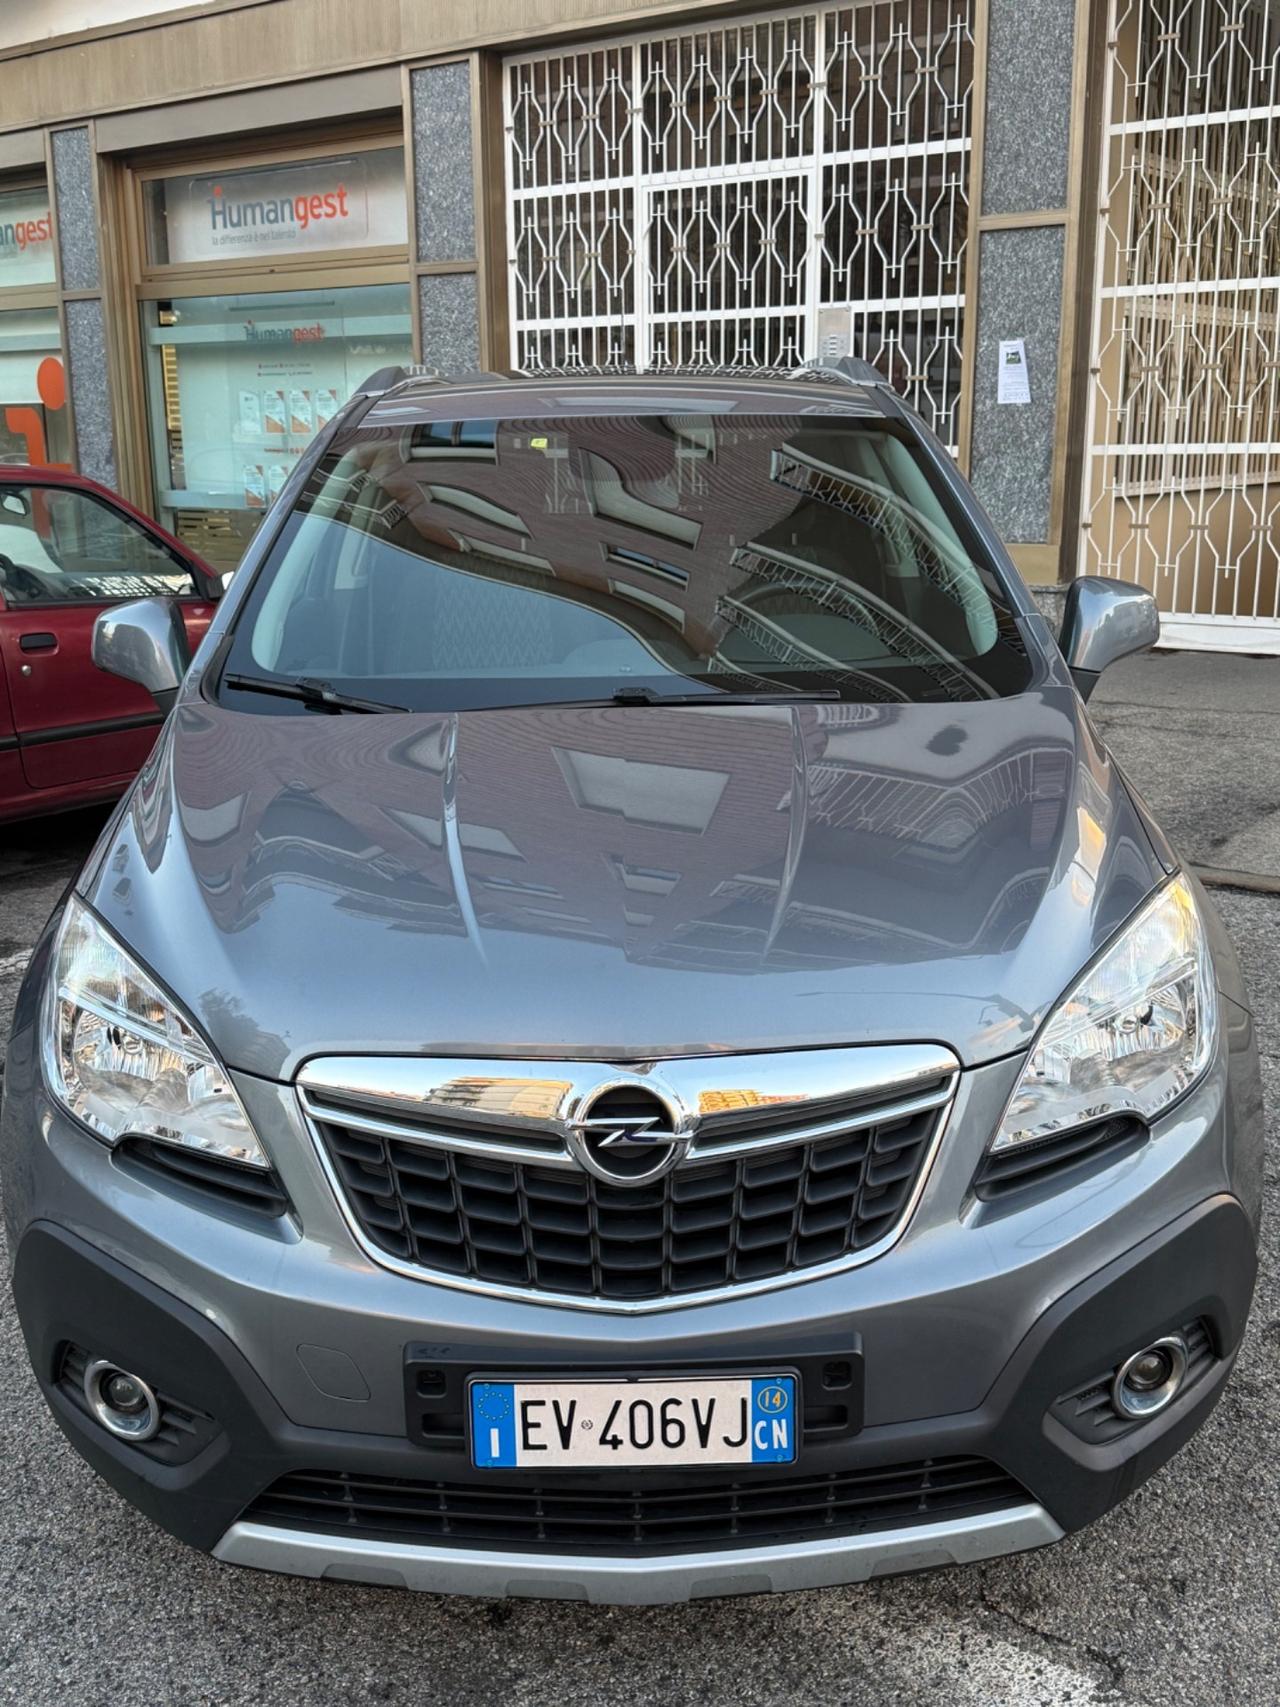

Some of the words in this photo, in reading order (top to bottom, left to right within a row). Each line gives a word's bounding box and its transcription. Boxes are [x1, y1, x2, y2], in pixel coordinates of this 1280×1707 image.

[208, 183, 349, 230] Humangest
[243, 320, 325, 344] Humangest
[765, 1391, 781, 1408] 14
[754, 1418, 788, 1450] CN
